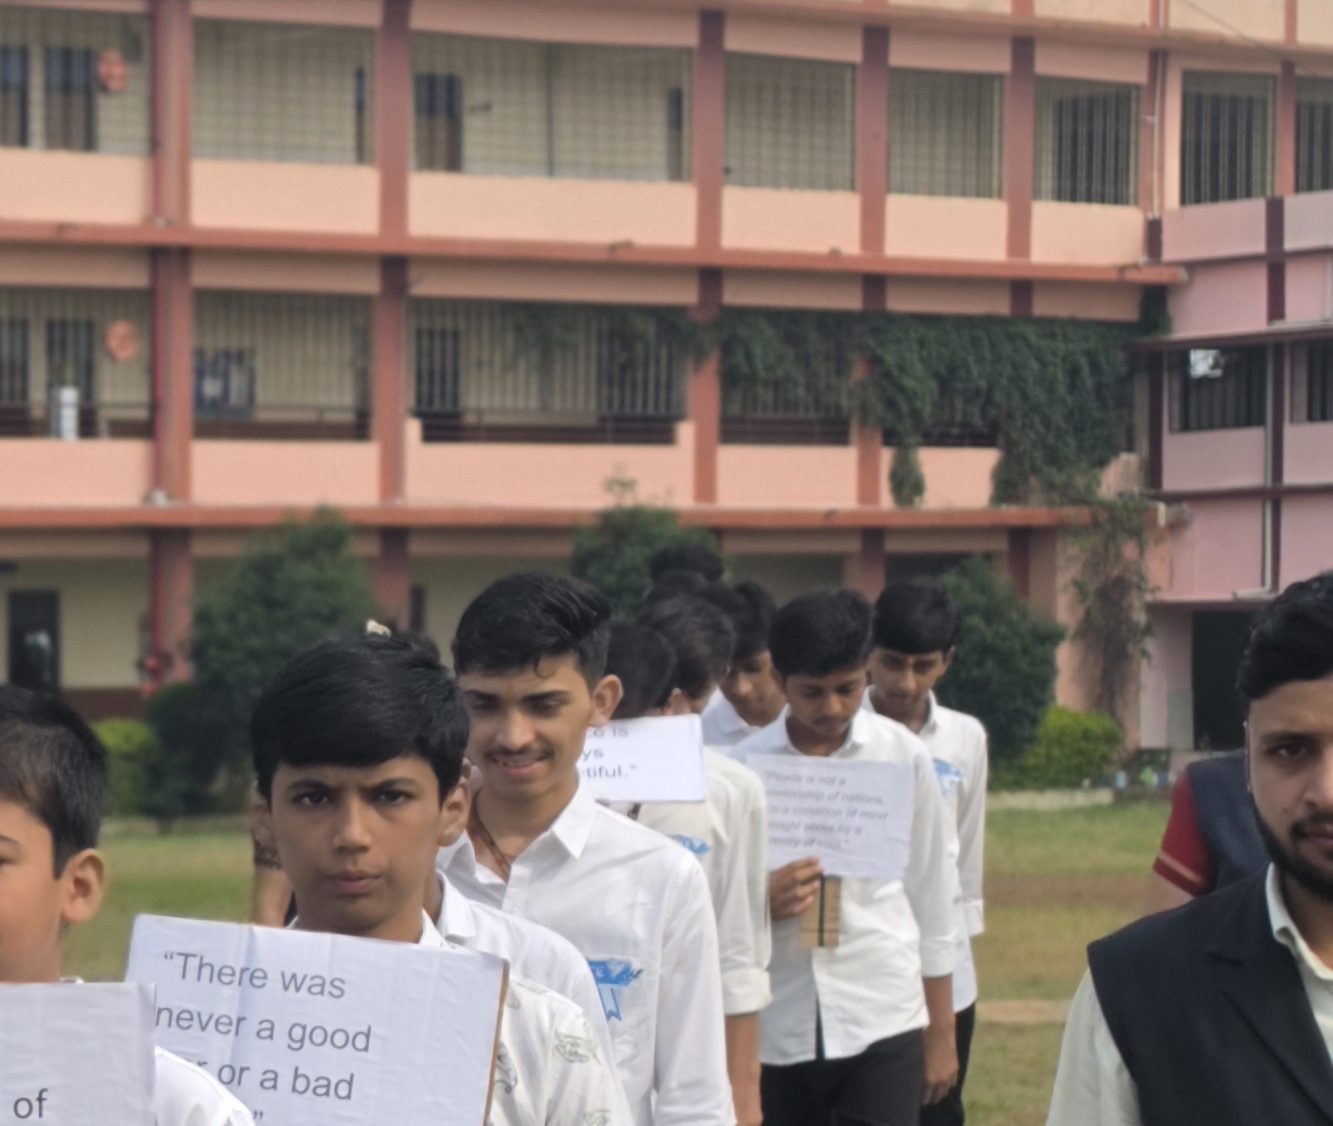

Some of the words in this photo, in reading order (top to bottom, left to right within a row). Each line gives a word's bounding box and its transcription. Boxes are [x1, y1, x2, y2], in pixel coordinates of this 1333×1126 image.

[280, 968, 347, 999] was
[155, 1003, 247, 1037] never
[256, 1019, 275, 1041] a
[286, 1023, 372, 1054] good
[217, 1063, 250, 1087] or
[259, 1068, 279, 1092] a
[291, 1066, 354, 1101] bad
[13, 1088, 48, 1120] of
